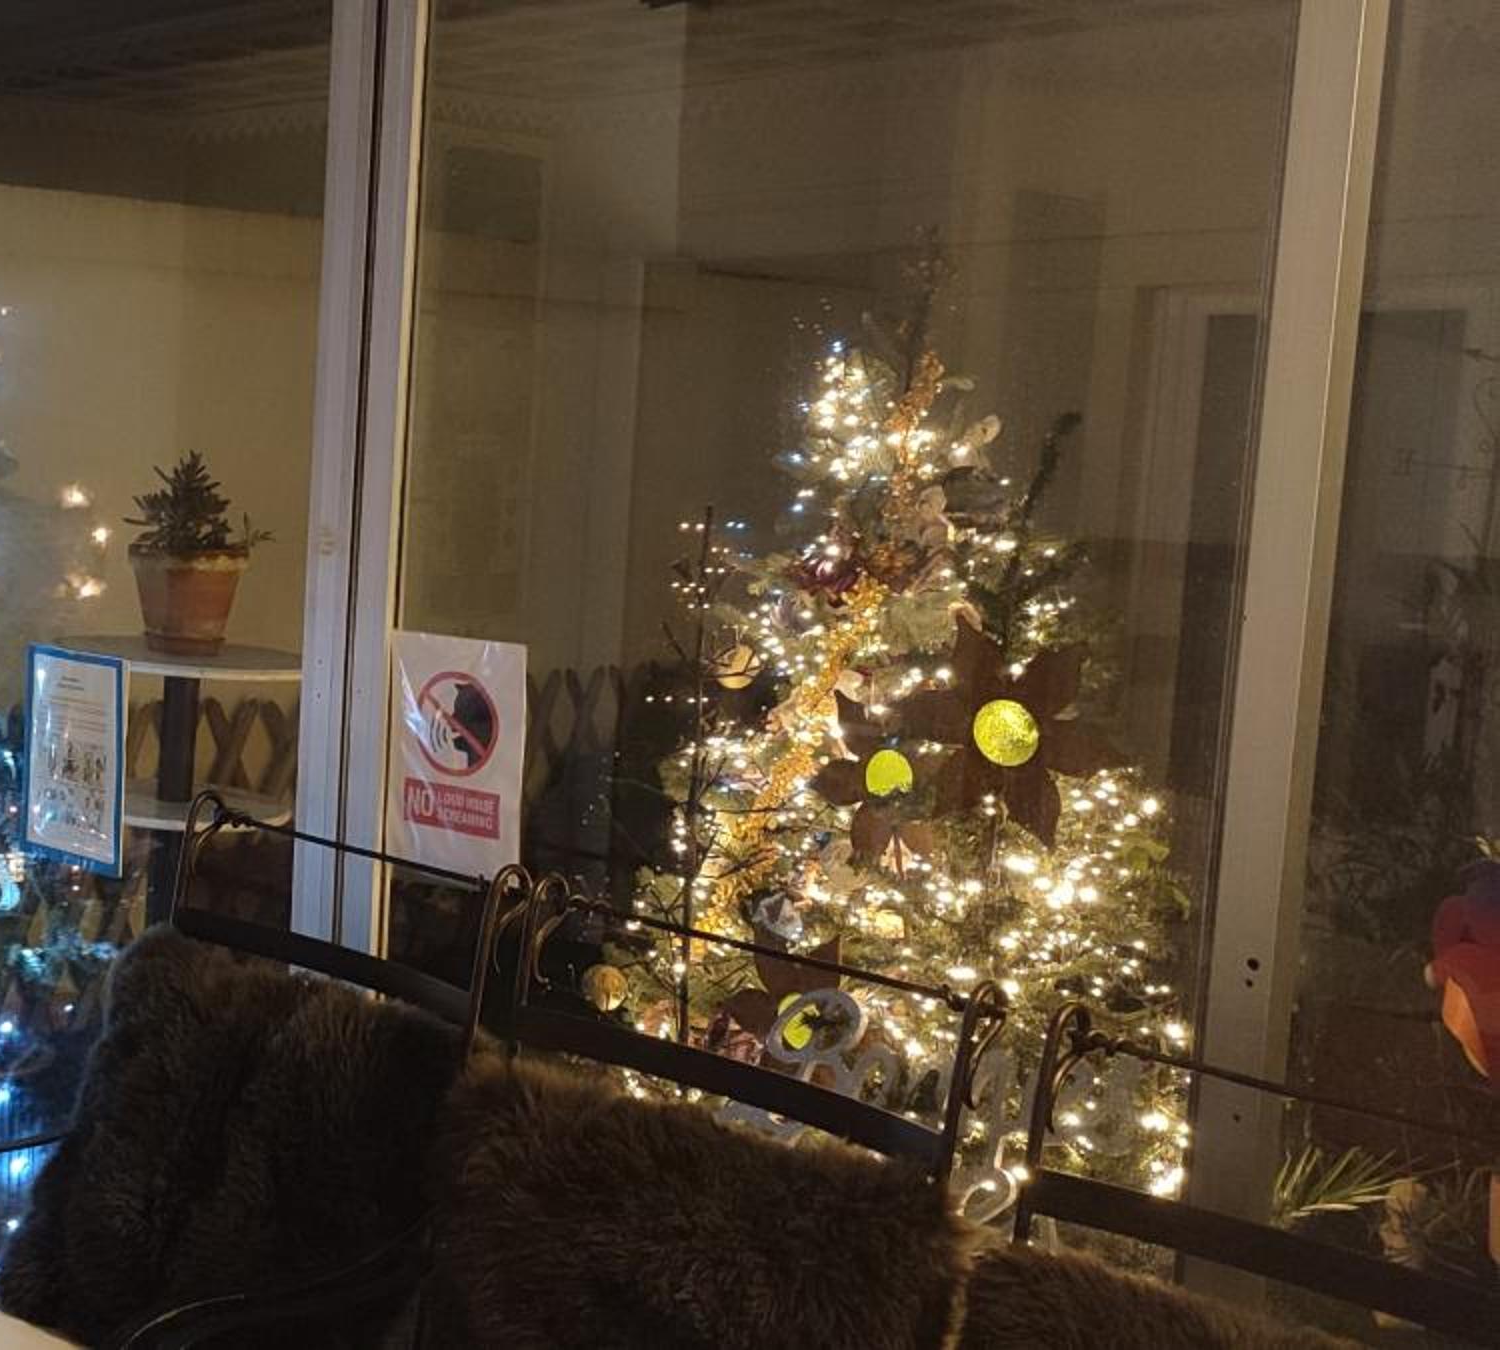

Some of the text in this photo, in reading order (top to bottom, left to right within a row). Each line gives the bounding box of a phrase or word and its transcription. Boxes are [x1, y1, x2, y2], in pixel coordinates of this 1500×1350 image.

[407, 785, 435, 817] NO
[436, 790, 465, 809] LOUD
[436, 806, 494, 831] SCREAMING
